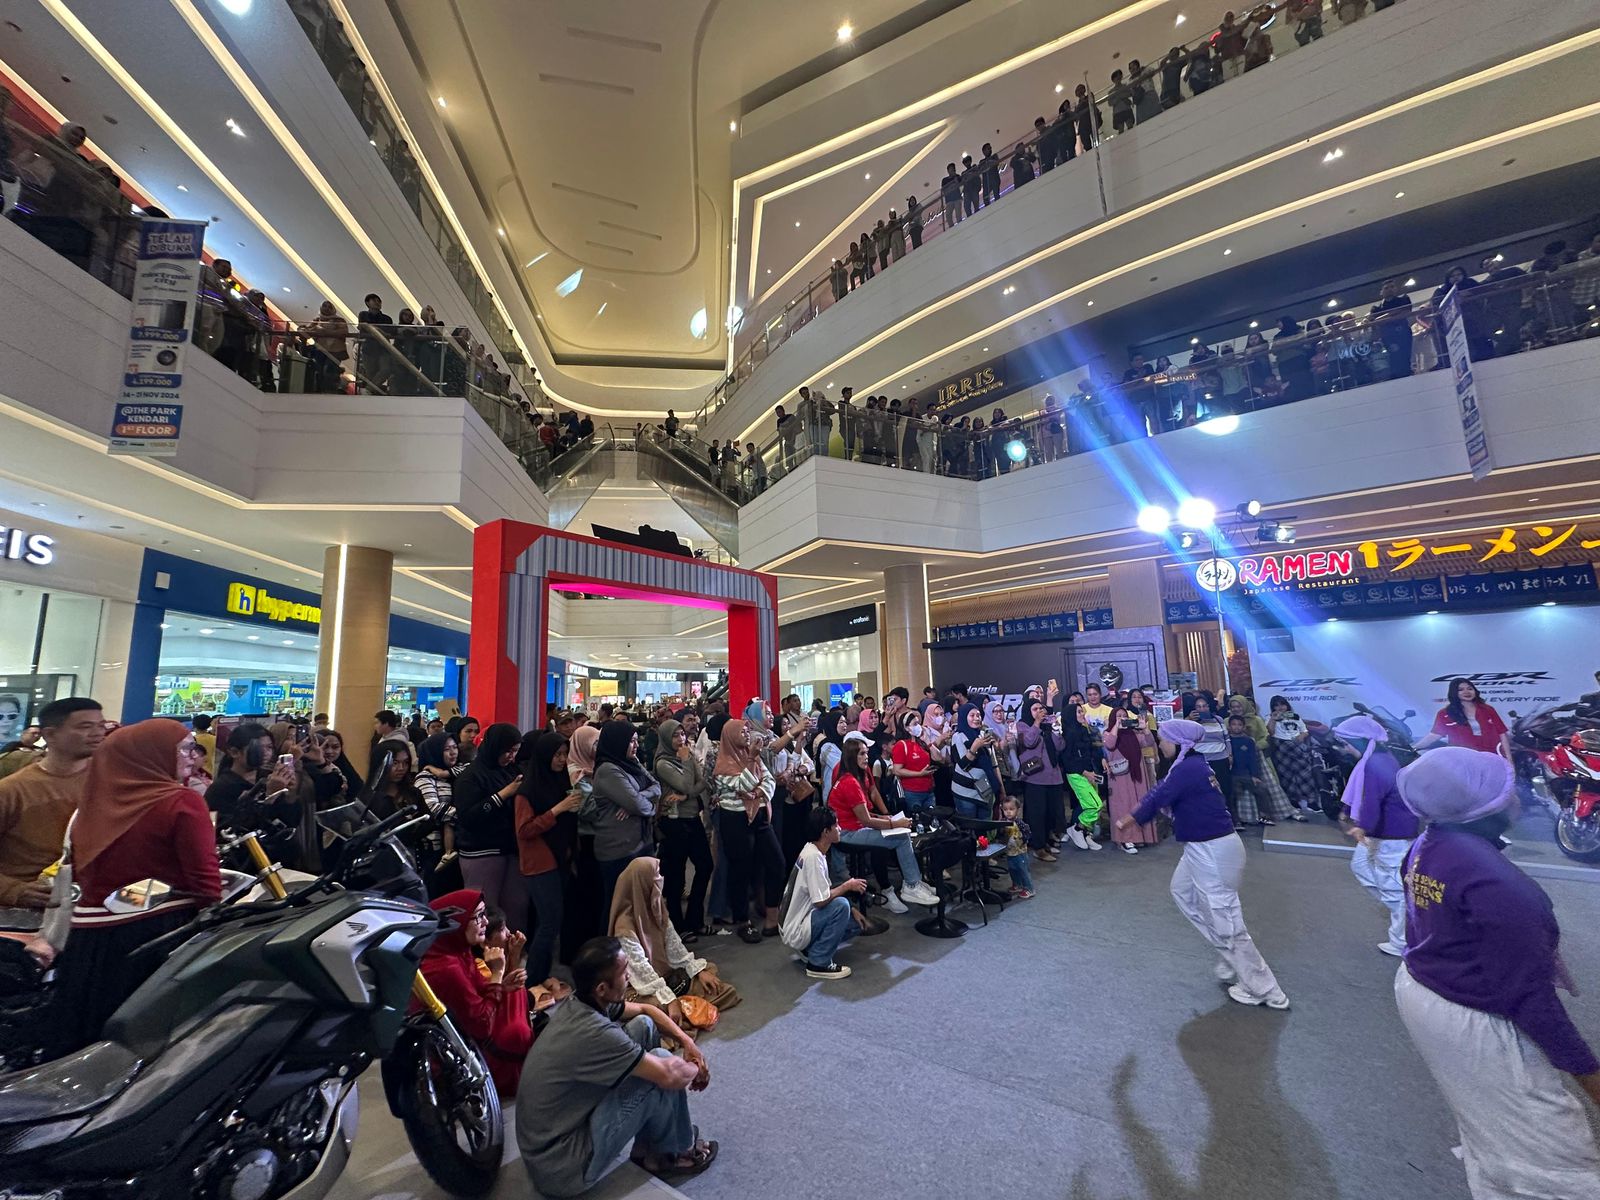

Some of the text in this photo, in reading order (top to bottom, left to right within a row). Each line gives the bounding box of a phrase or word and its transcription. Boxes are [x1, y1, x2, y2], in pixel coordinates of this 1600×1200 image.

[149, 233, 193, 244] TELAH
[938, 367, 995, 404] IRRIS
[121, 406, 177, 416] @THE PARK
[127, 416, 169, 424] KENDARI
[136, 427, 172, 435] FLOOR
[1239, 550, 1352, 585] RAMEN
[1243, 577, 1361, 596] Japanese Restaurant
[646, 672, 678, 681] THE PALACE
[1431, 671, 1556, 682] CBR
[1259, 677, 1362, 687] CBR
